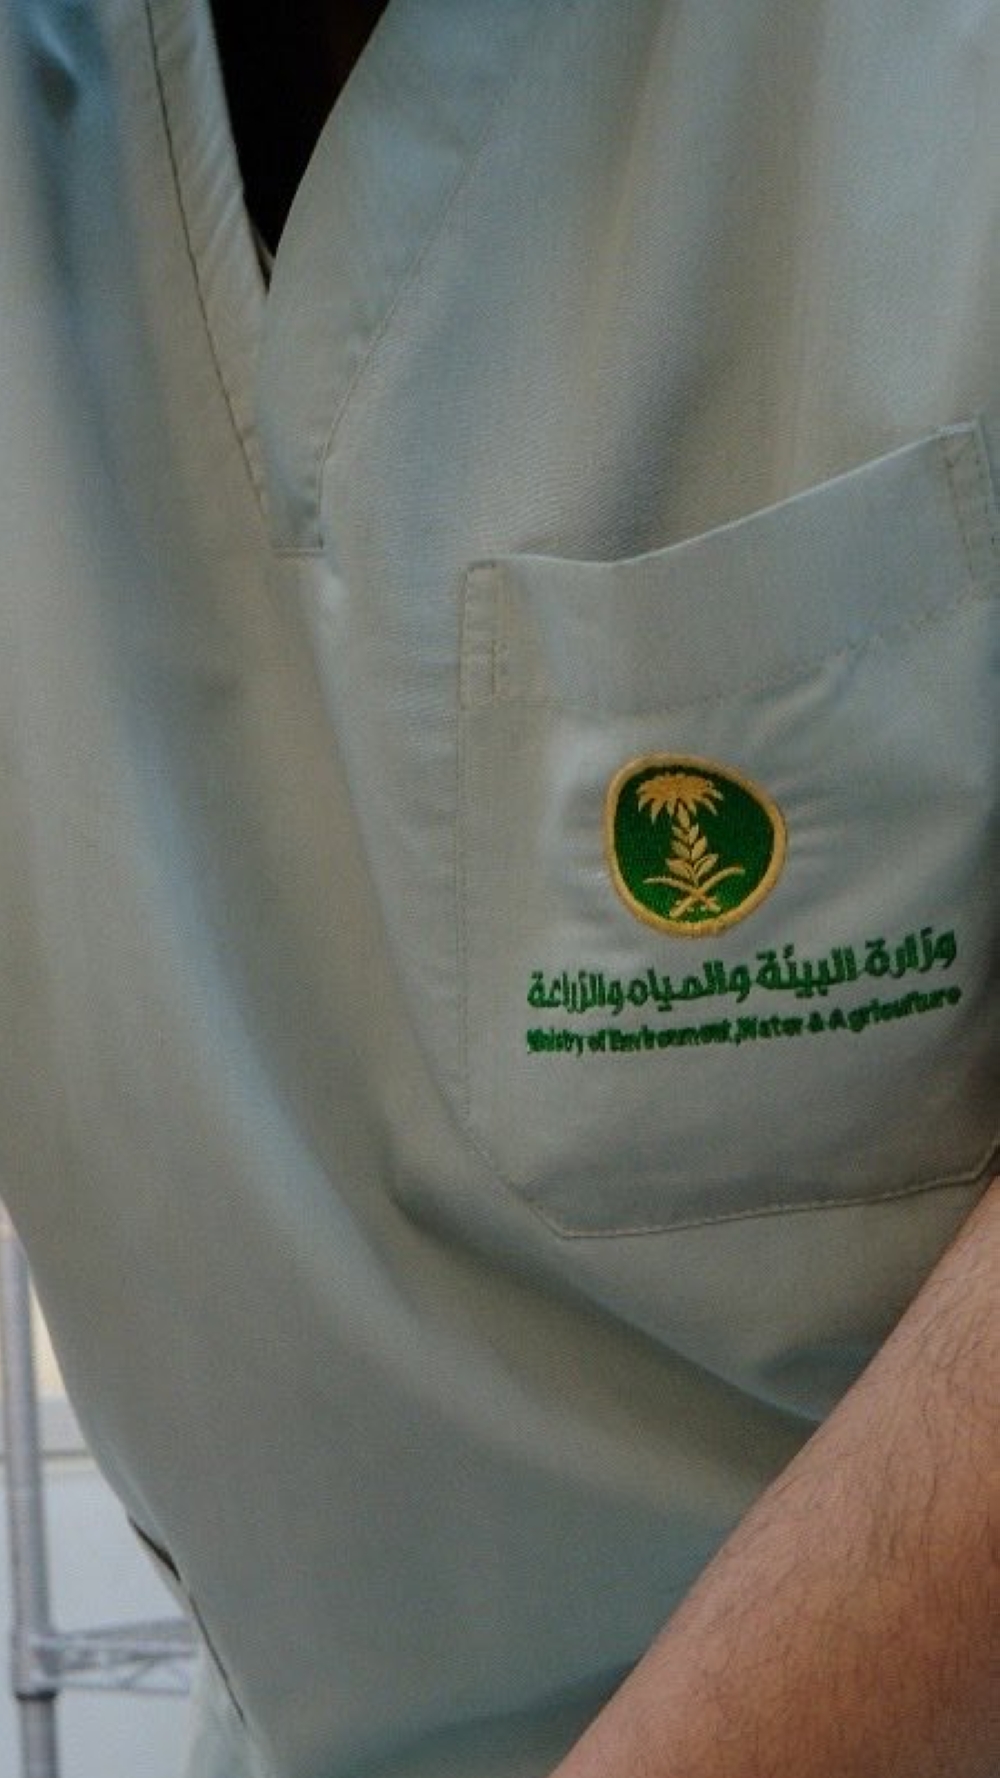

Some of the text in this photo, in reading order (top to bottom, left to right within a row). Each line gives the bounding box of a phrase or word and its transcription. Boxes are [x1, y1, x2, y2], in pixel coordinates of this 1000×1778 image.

[527, 927, 957, 1015] وزارة البيئة والمياه والزراعة
